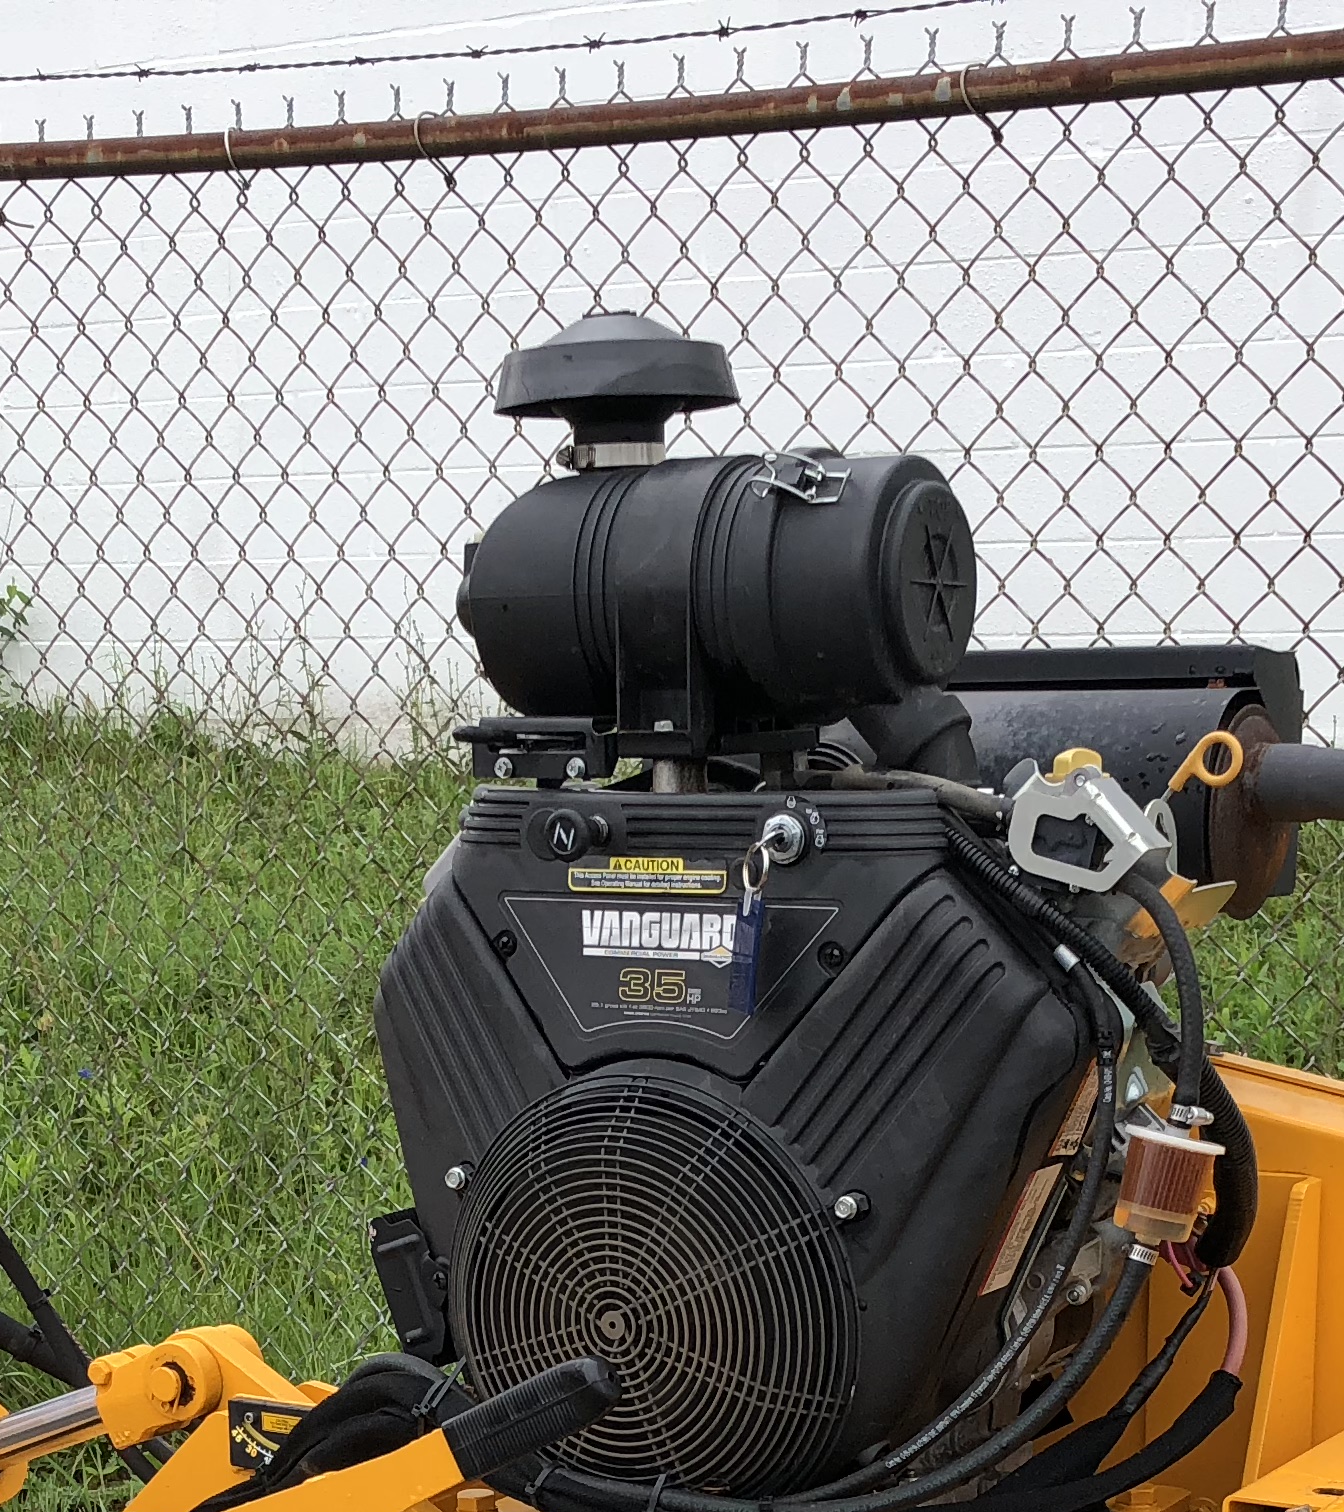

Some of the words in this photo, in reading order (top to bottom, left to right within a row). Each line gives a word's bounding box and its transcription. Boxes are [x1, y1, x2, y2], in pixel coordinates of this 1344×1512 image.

[624, 859, 680, 871] CAUTION
[582, 909, 737, 950] VANGUARD
[604, 950, 650, 958] COMMERCIAL
[619, 968, 686, 1003] 35
[687, 993, 701, 1004] HP
[245, 1444, 258, 1458] 30
